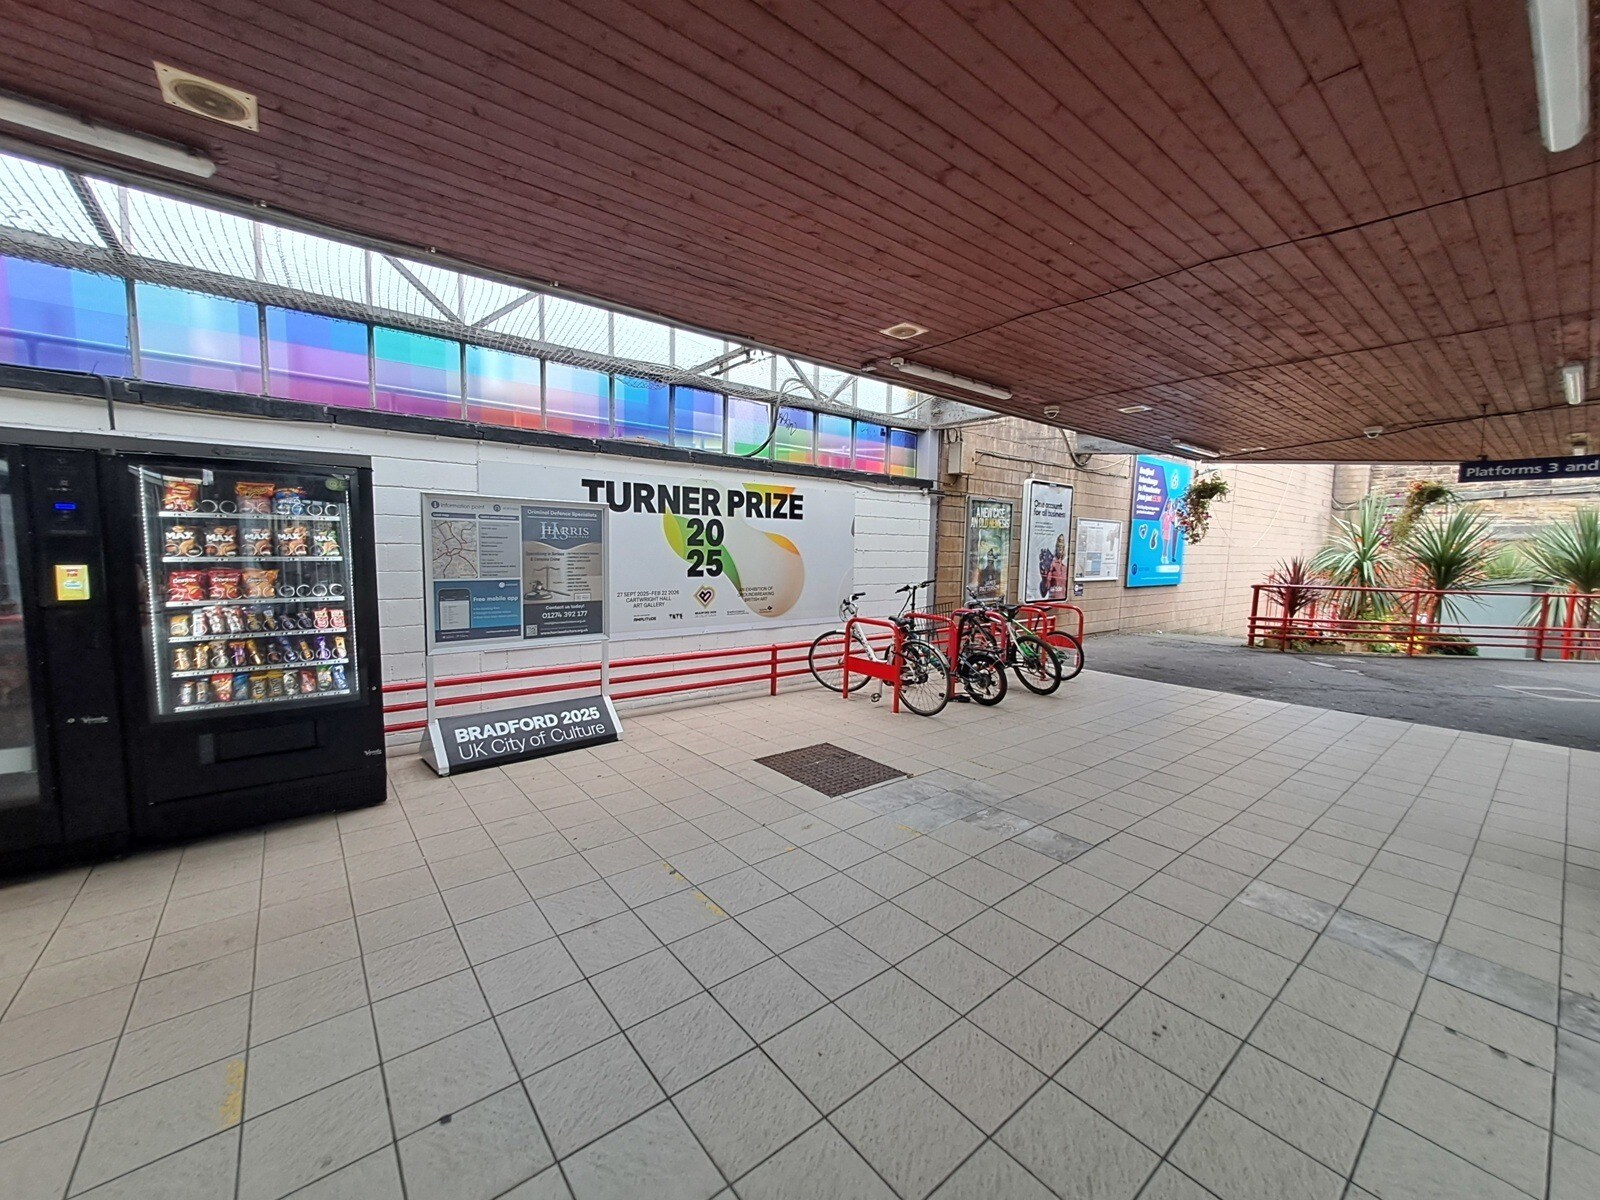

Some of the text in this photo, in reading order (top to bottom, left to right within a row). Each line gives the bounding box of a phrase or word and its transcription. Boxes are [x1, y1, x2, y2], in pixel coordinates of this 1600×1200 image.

[1466, 460, 1599, 477] Platforms 3 and
[581, 478, 804, 520] TURNER PRIZE
[1034, 499, 1045, 507] One
[977, 506, 1005, 518] A NEW CASE
[971, 517, 978, 528] AN
[979, 517, 989, 528] OLD
[165, 531, 195, 540] MAX
[278, 533, 301, 541] MAX
[541, 526, 589, 536] HARRIS
[687, 518, 724, 547] 20
[205, 533, 235, 542] MAX
[687, 550, 723, 577] 25
[454, 706, 600, 744] BRADFORD 2025
[458, 722, 606, 761] UK City of Culture
